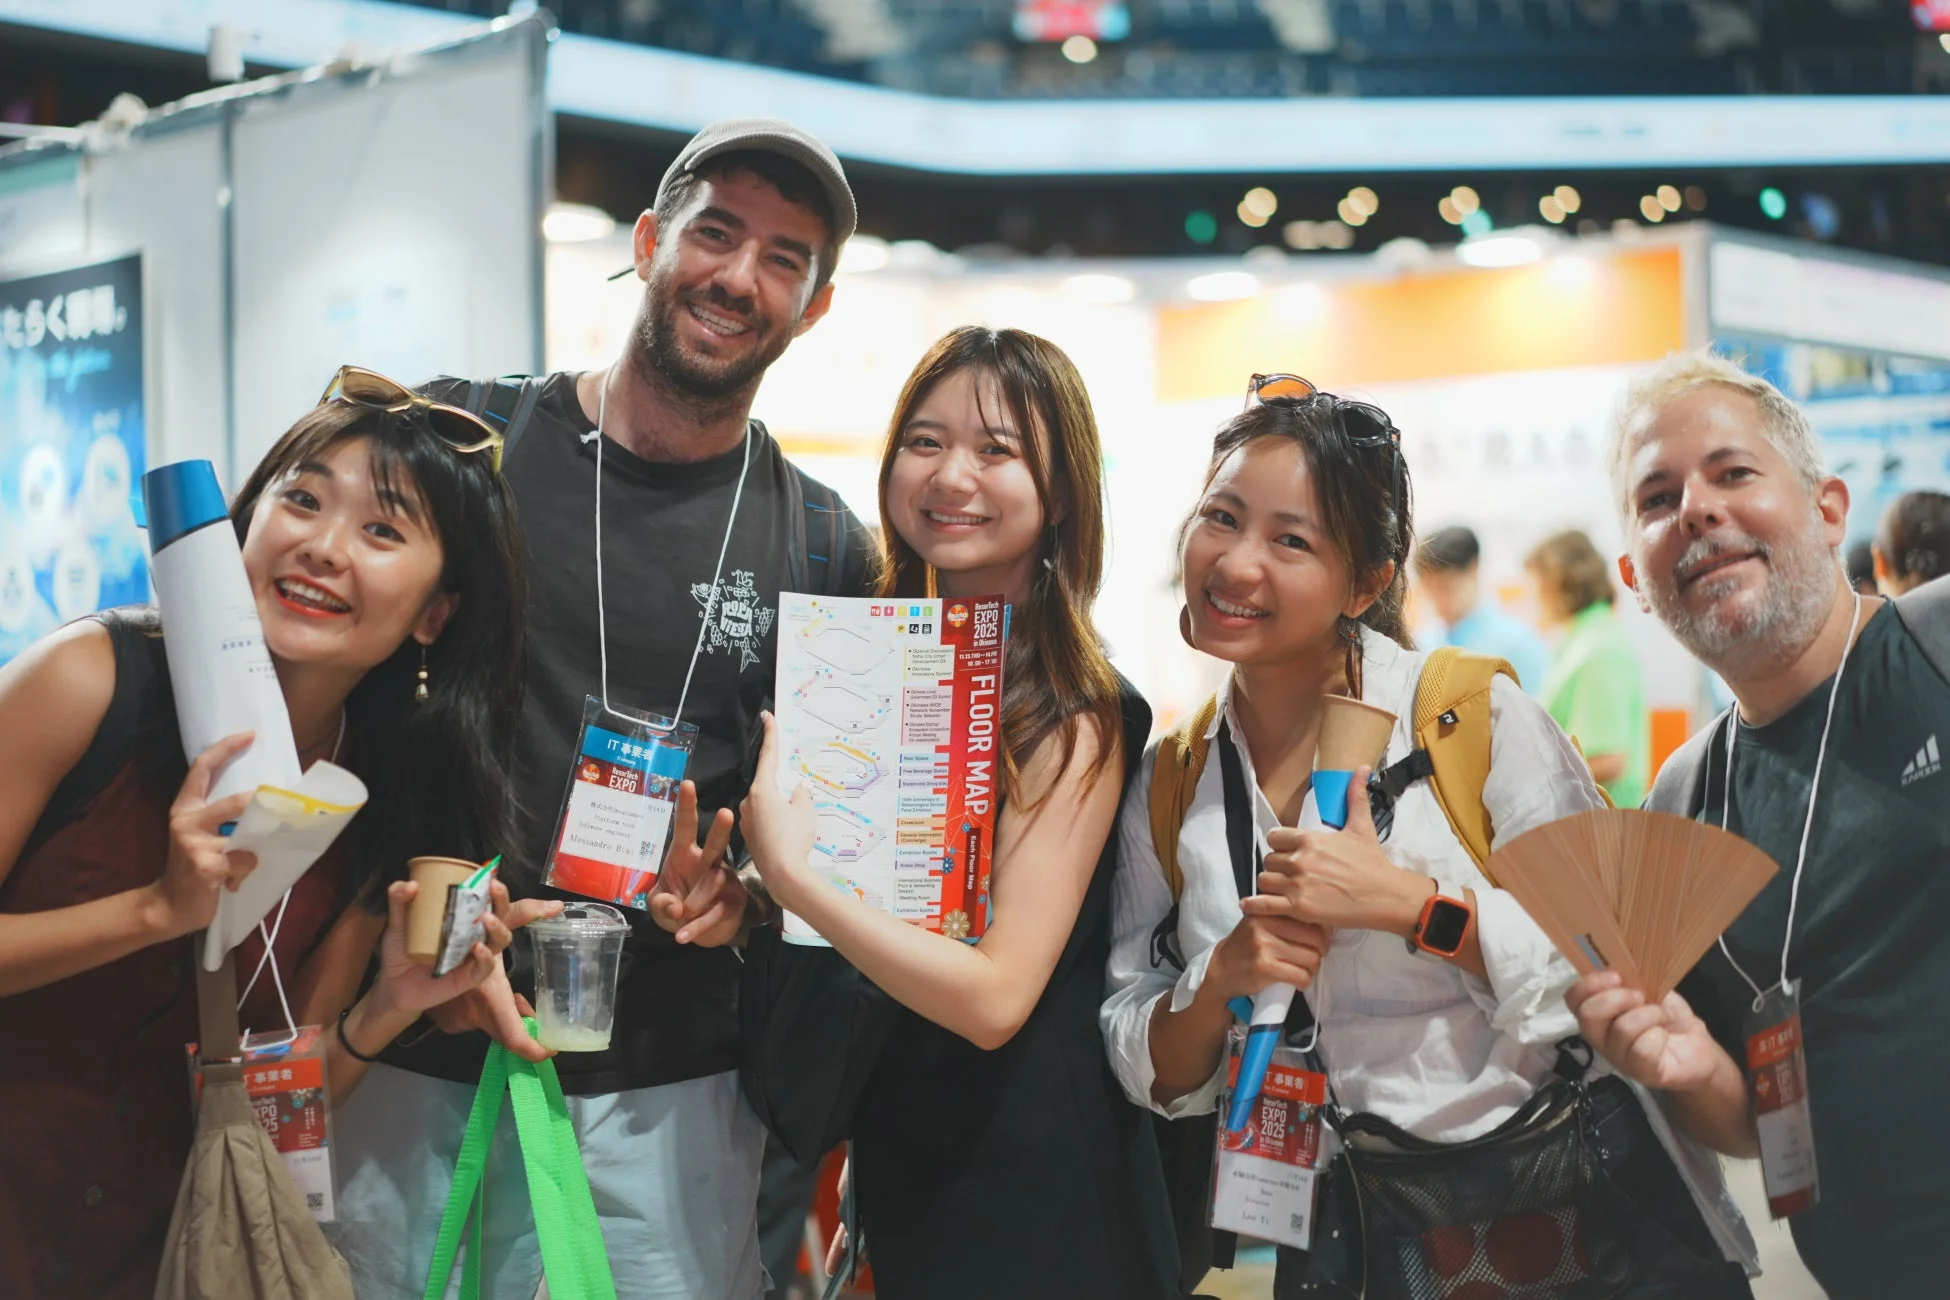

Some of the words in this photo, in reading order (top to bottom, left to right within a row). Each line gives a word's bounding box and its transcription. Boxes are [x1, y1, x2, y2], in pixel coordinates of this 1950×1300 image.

[974, 610, 998, 624] EXPO
[973, 622, 998, 639] 2025
[967, 674, 996, 754] FLOOR
[607, 738, 620, 751] IT
[620, 742, 654, 761] 事業者
[612, 766, 639, 780] ResorTech
[608, 774, 637, 793] EXPO
[964, 760, 992, 816] MAP
[569, 833, 612, 850] Alessandro
[968, 854, 976, 874] Floor
[254, 1068, 293, 1084] 事業者
[1275, 1072, 1304, 1090] 事業者
[1261, 1106, 1287, 1123] EXPO
[1260, 1119, 1286, 1140] 2025
